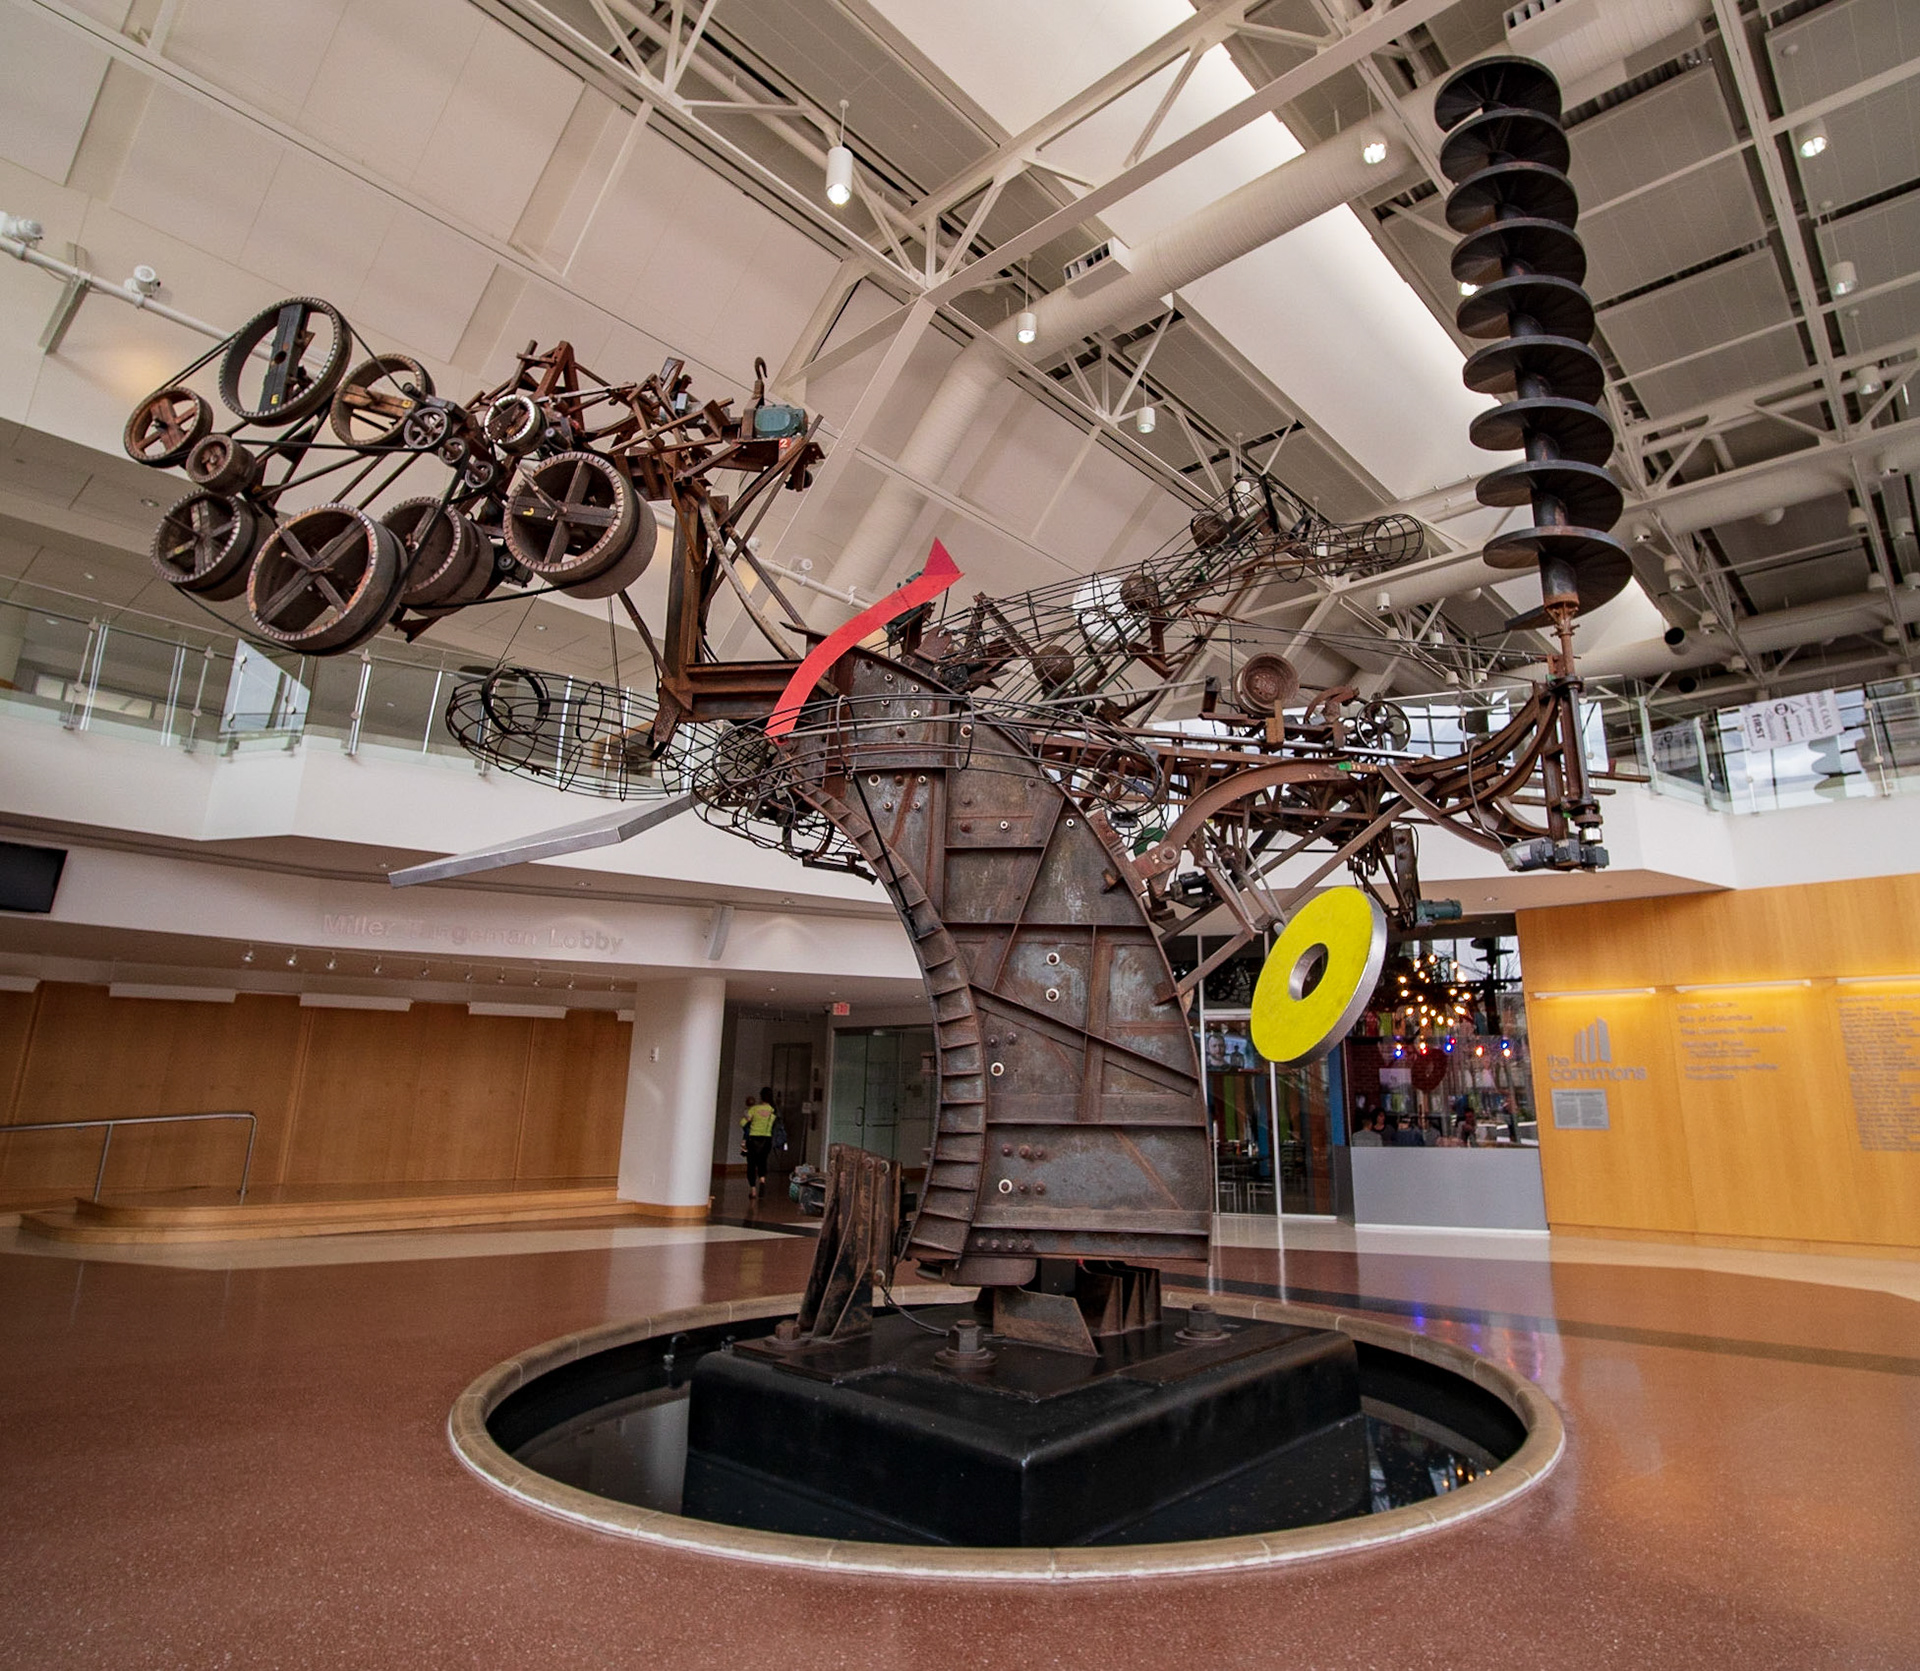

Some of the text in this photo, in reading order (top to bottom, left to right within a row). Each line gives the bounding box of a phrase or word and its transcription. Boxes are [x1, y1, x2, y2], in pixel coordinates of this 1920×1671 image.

[780, 438, 788, 448] 2
[321, 914, 393, 936] Miller
[549, 928, 624, 955] Lobby
[1547, 1054, 1570, 1067] the
[1549, 1066, 1647, 1081] commons
